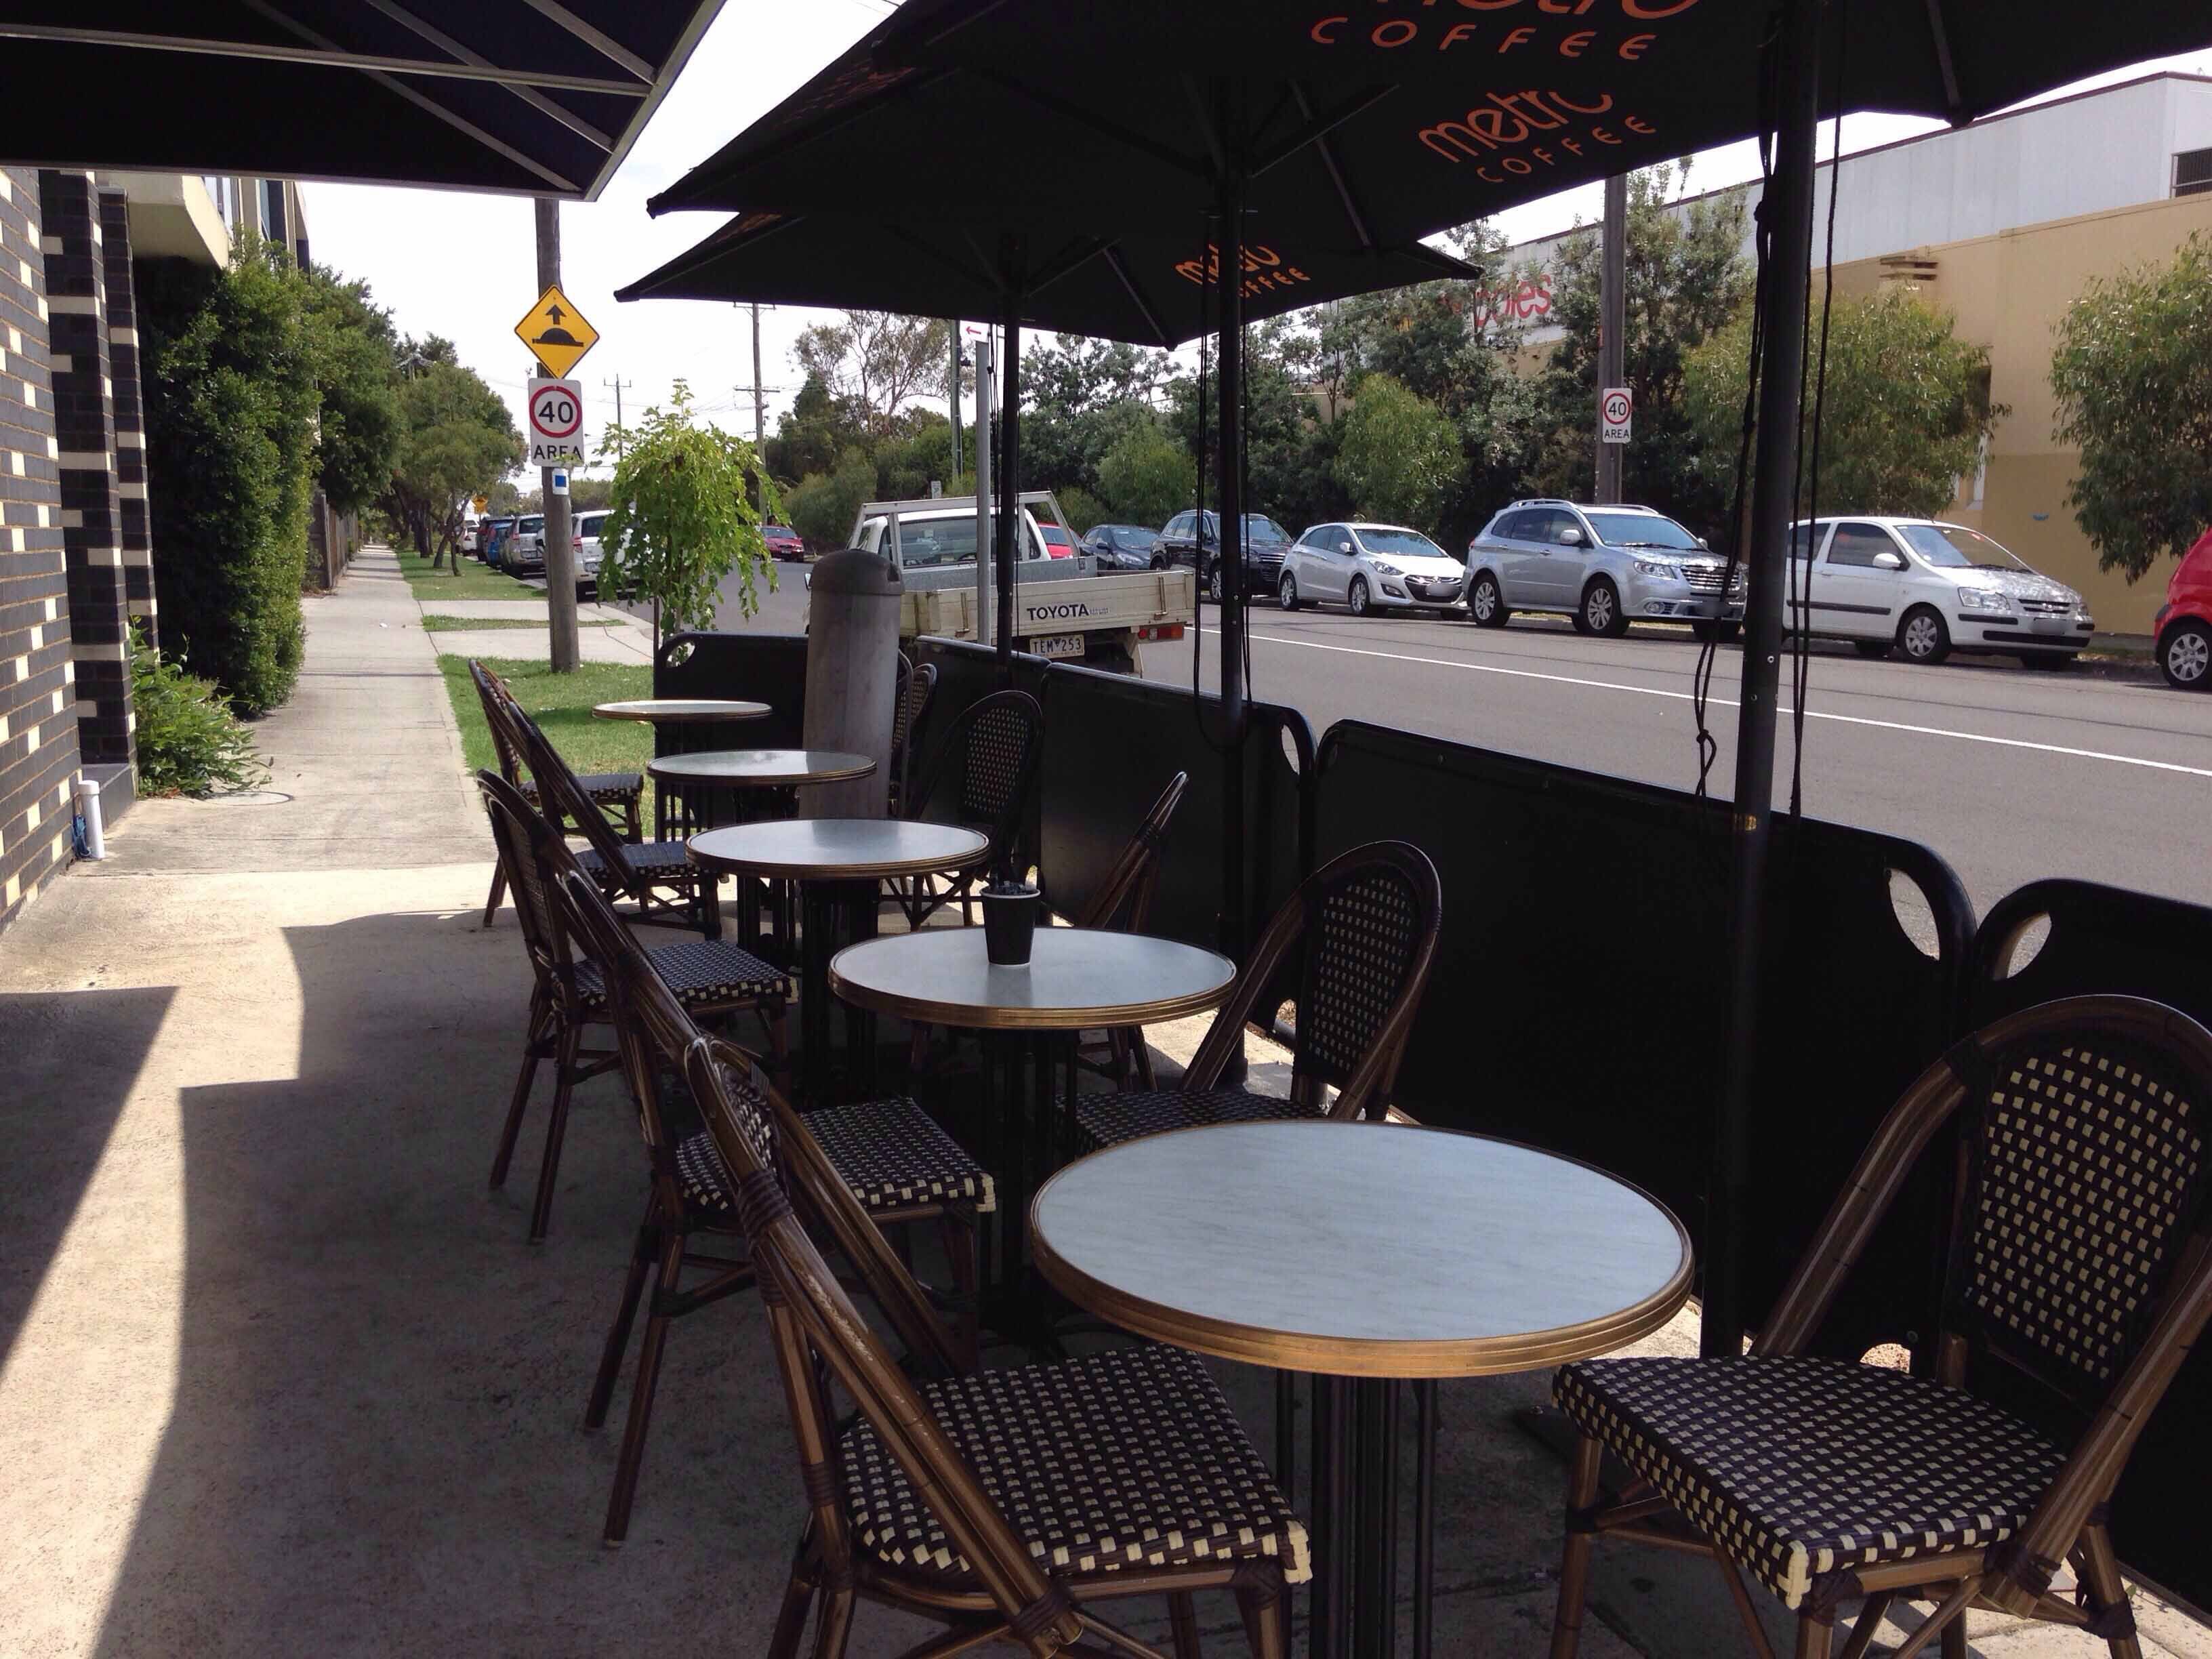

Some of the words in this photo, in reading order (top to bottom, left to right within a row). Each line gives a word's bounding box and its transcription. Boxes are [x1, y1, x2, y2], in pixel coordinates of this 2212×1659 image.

[1311, 17, 1656, 60] COFFEE
[1477, 115, 1656, 183] COFFEE
[1237, 267, 1311, 298] OFFEE
[539, 401, 573, 424] 40
[1608, 401, 1626, 415] 40
[1604, 429, 1629, 438] AREA
[533, 445, 582, 460] AREA
[1027, 604, 1089, 621] TOYOTA
